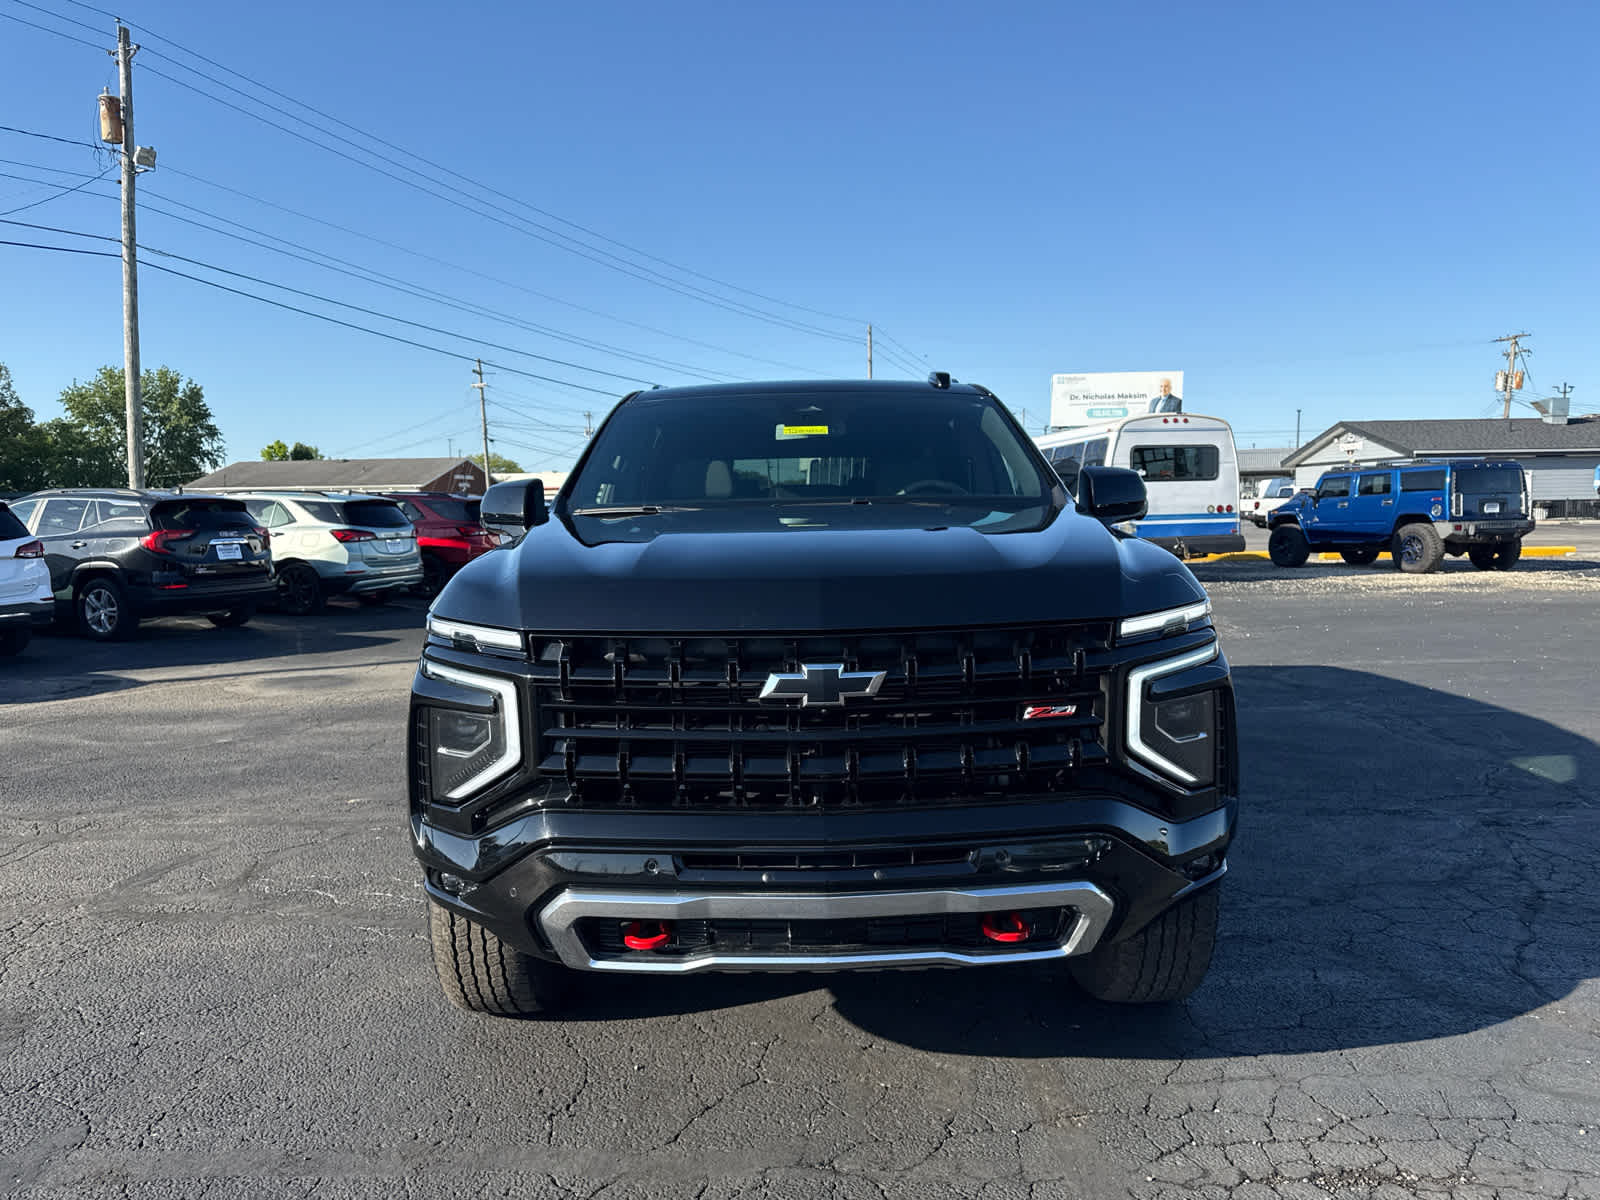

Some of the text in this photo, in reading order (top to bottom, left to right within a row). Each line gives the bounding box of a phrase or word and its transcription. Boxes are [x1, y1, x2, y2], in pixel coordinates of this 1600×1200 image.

[1083, 392, 1115, 400] Nicholas
[1117, 391, 1148, 399] Maksim
[1023, 704, 1077, 719] Z71
